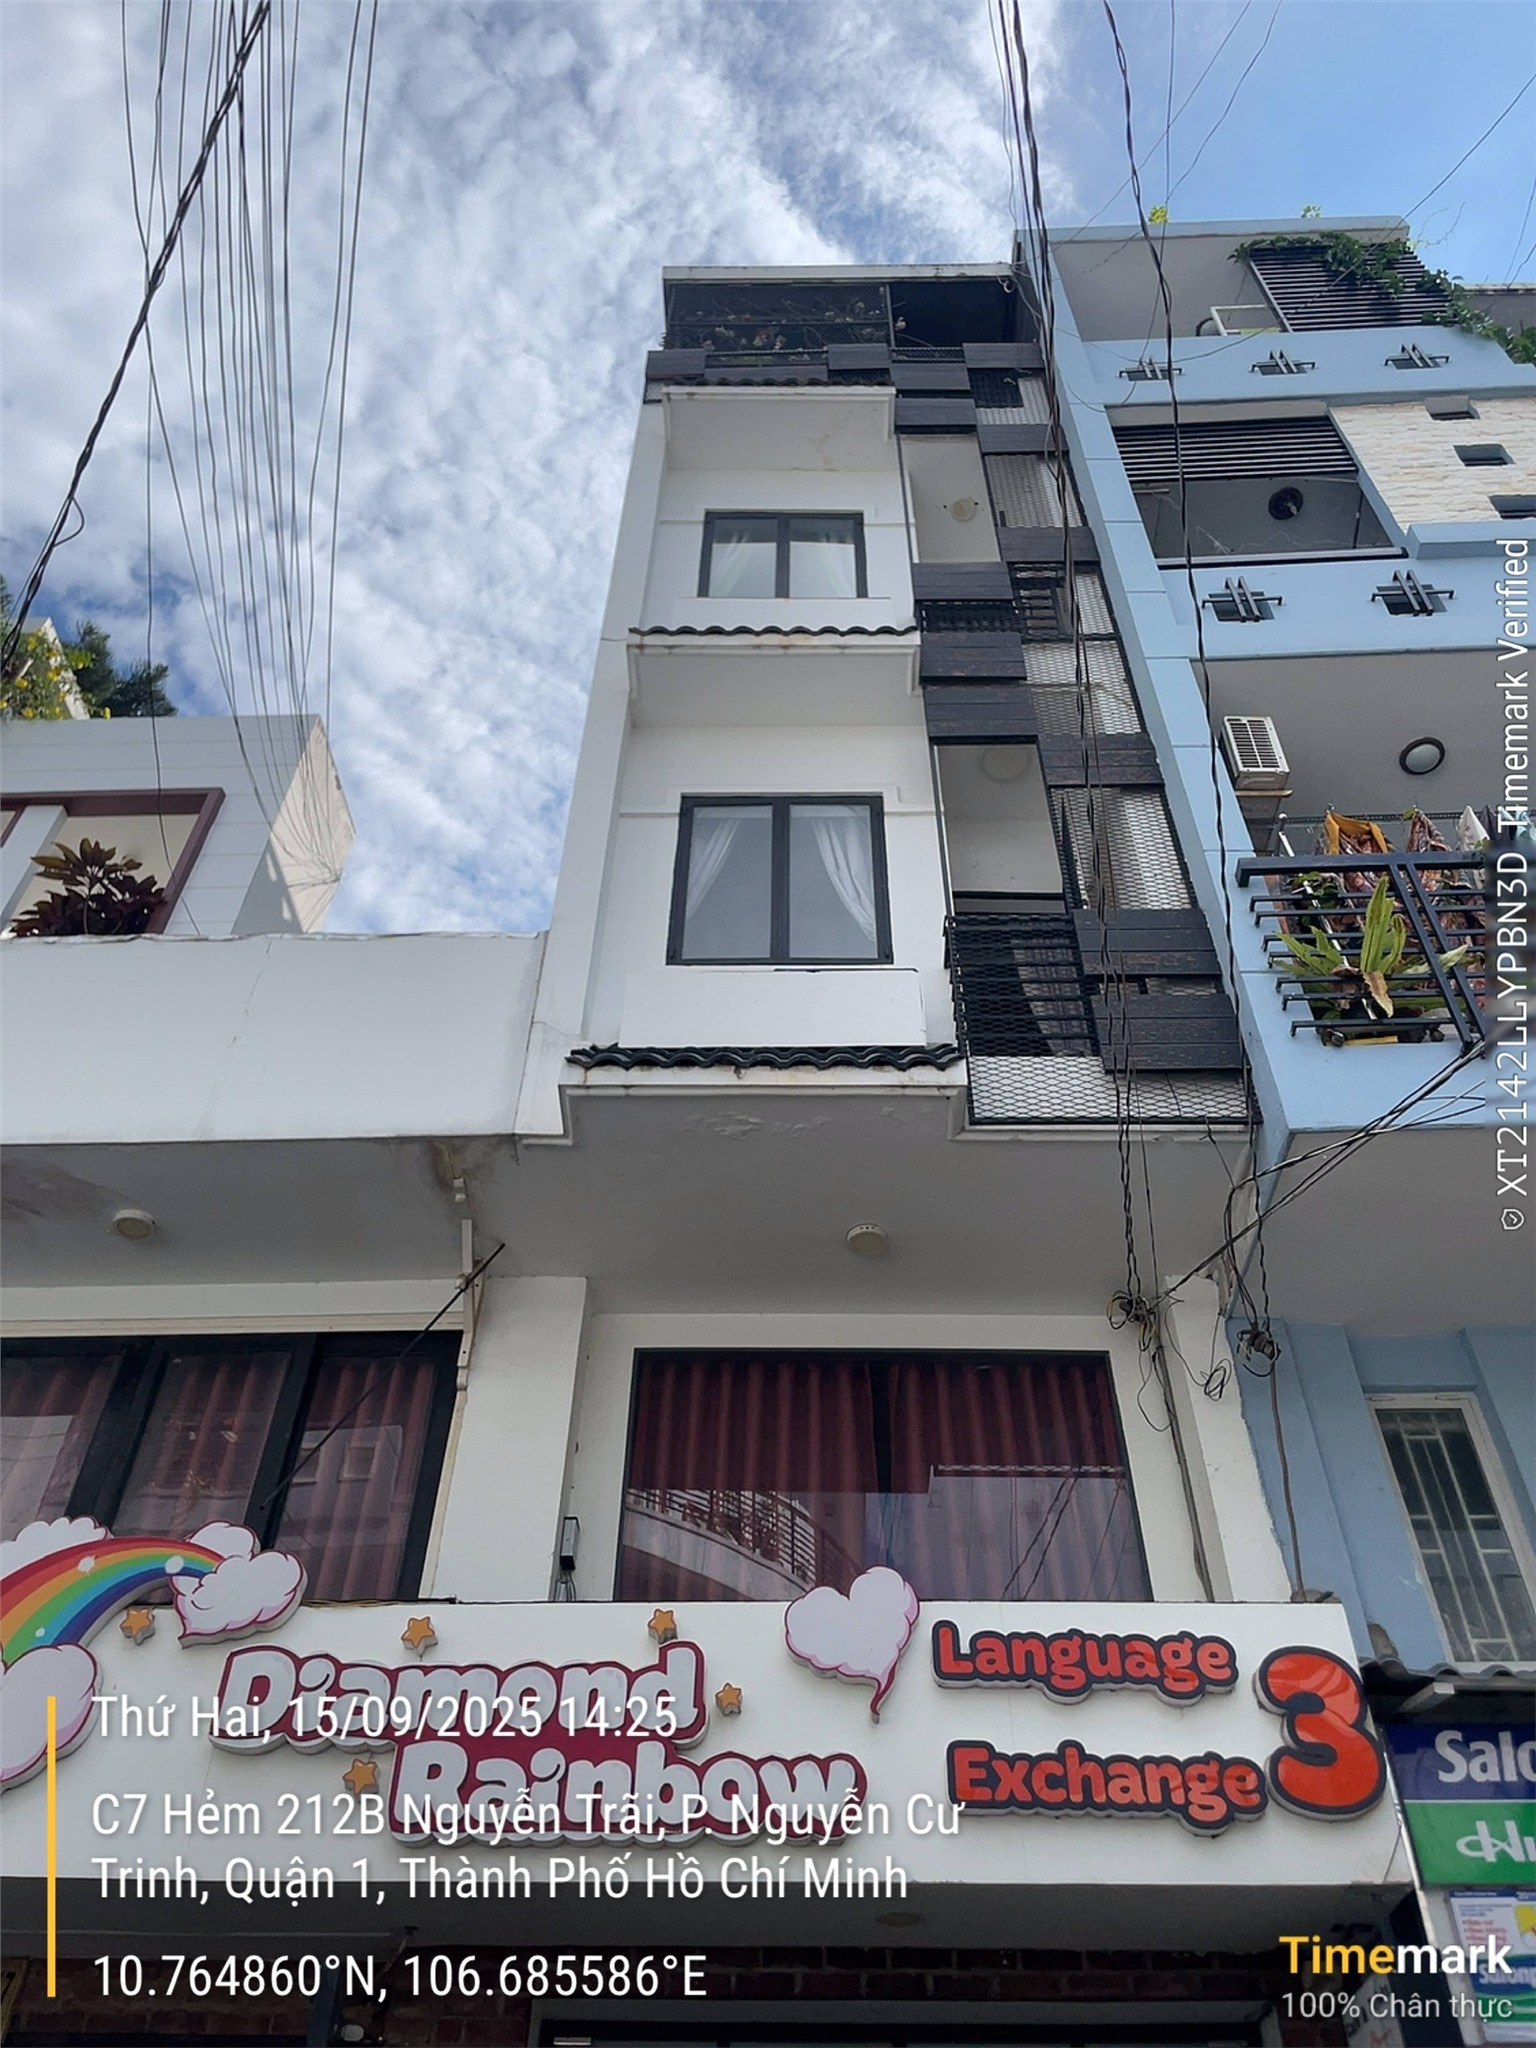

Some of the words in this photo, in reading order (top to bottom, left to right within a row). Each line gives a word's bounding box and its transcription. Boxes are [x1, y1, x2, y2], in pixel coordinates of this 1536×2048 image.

[212, 1640, 706, 1742] Diamond
[933, 1622, 1238, 1699] Language
[1262, 1648, 1386, 1816] 3
[392, 1739, 868, 1838] Rainbow
[948, 1741, 1265, 1826] Exchange
